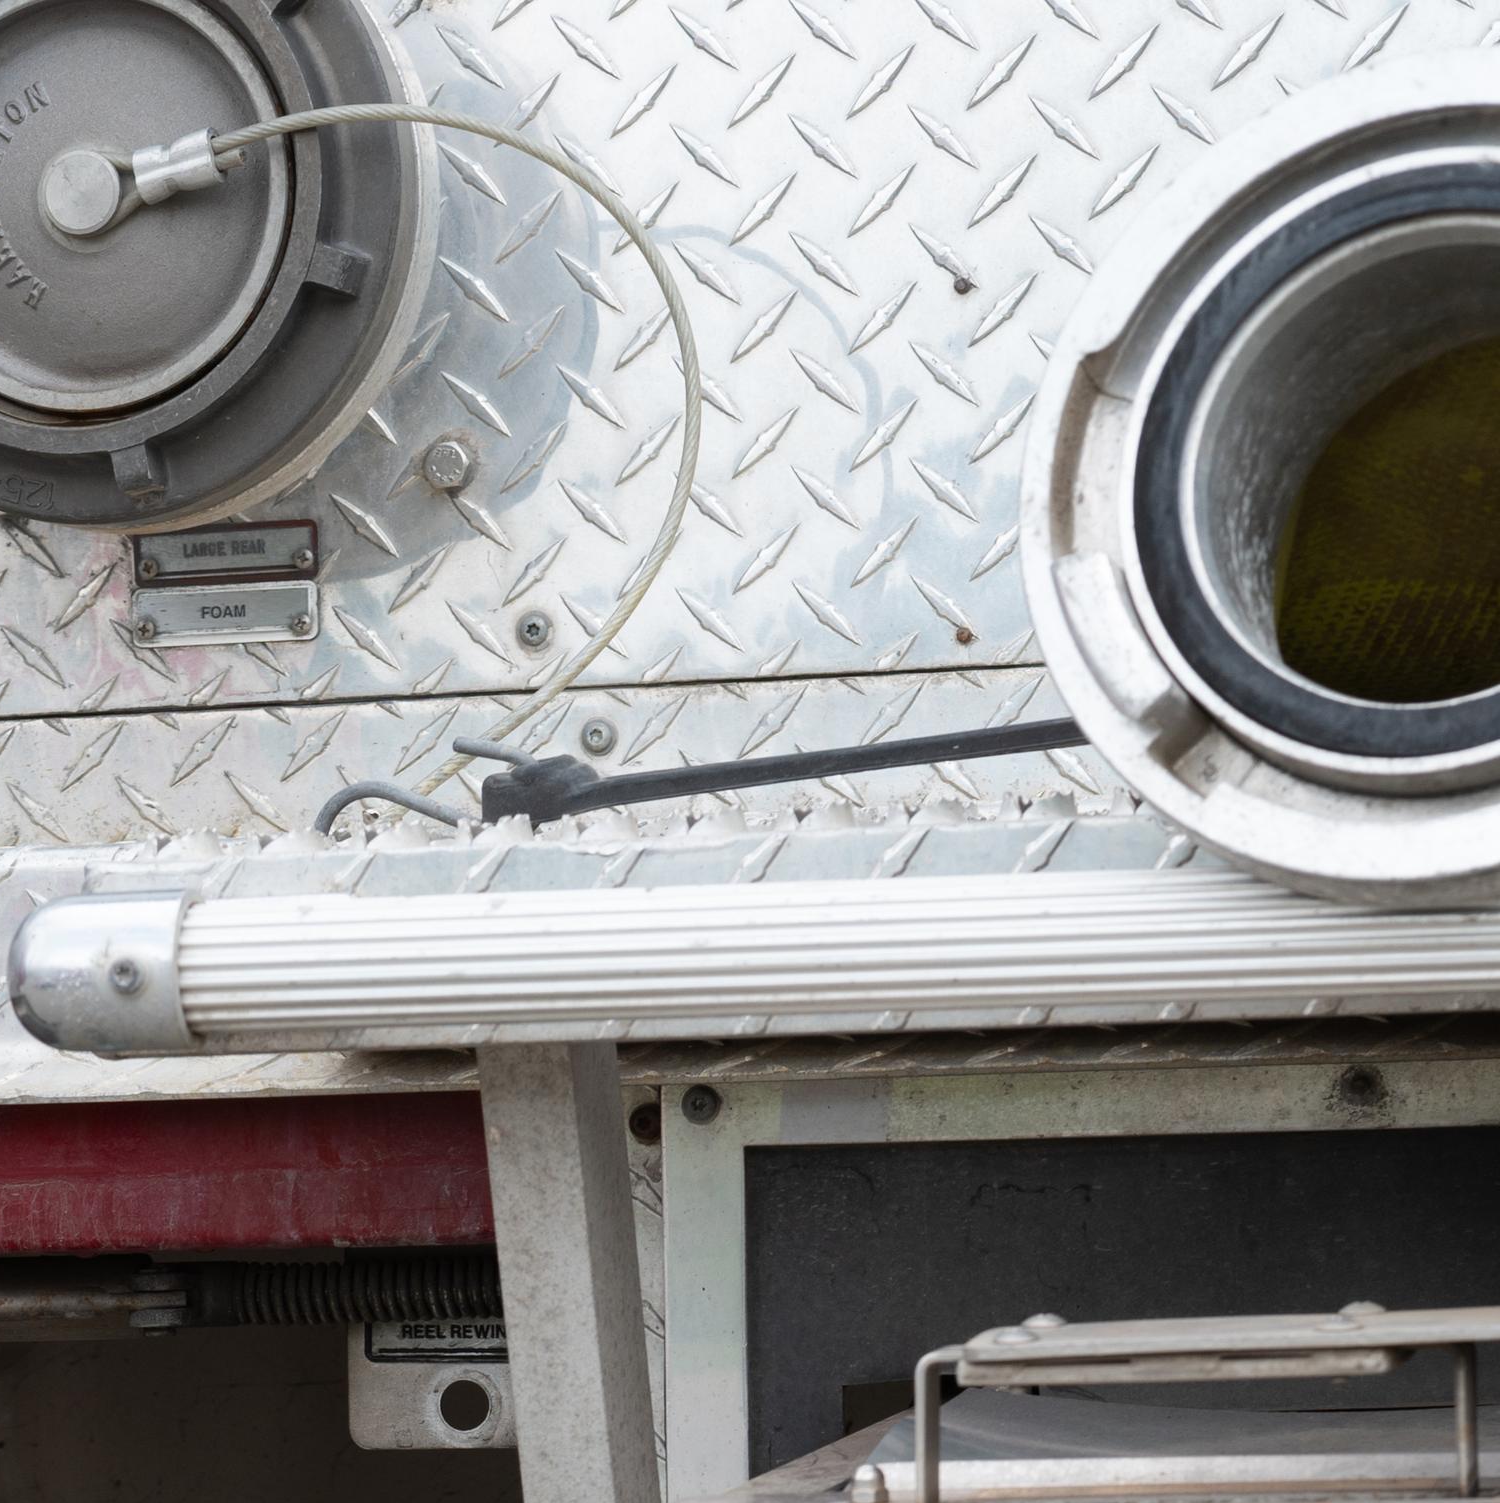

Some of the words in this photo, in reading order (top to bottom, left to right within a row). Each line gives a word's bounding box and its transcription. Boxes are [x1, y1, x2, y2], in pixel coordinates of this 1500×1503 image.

[183, 541, 228, 558] LARGE
[231, 538, 266, 556] REAR
[201, 604, 247, 619] FOAM
[402, 1324, 446, 1339] REEL
